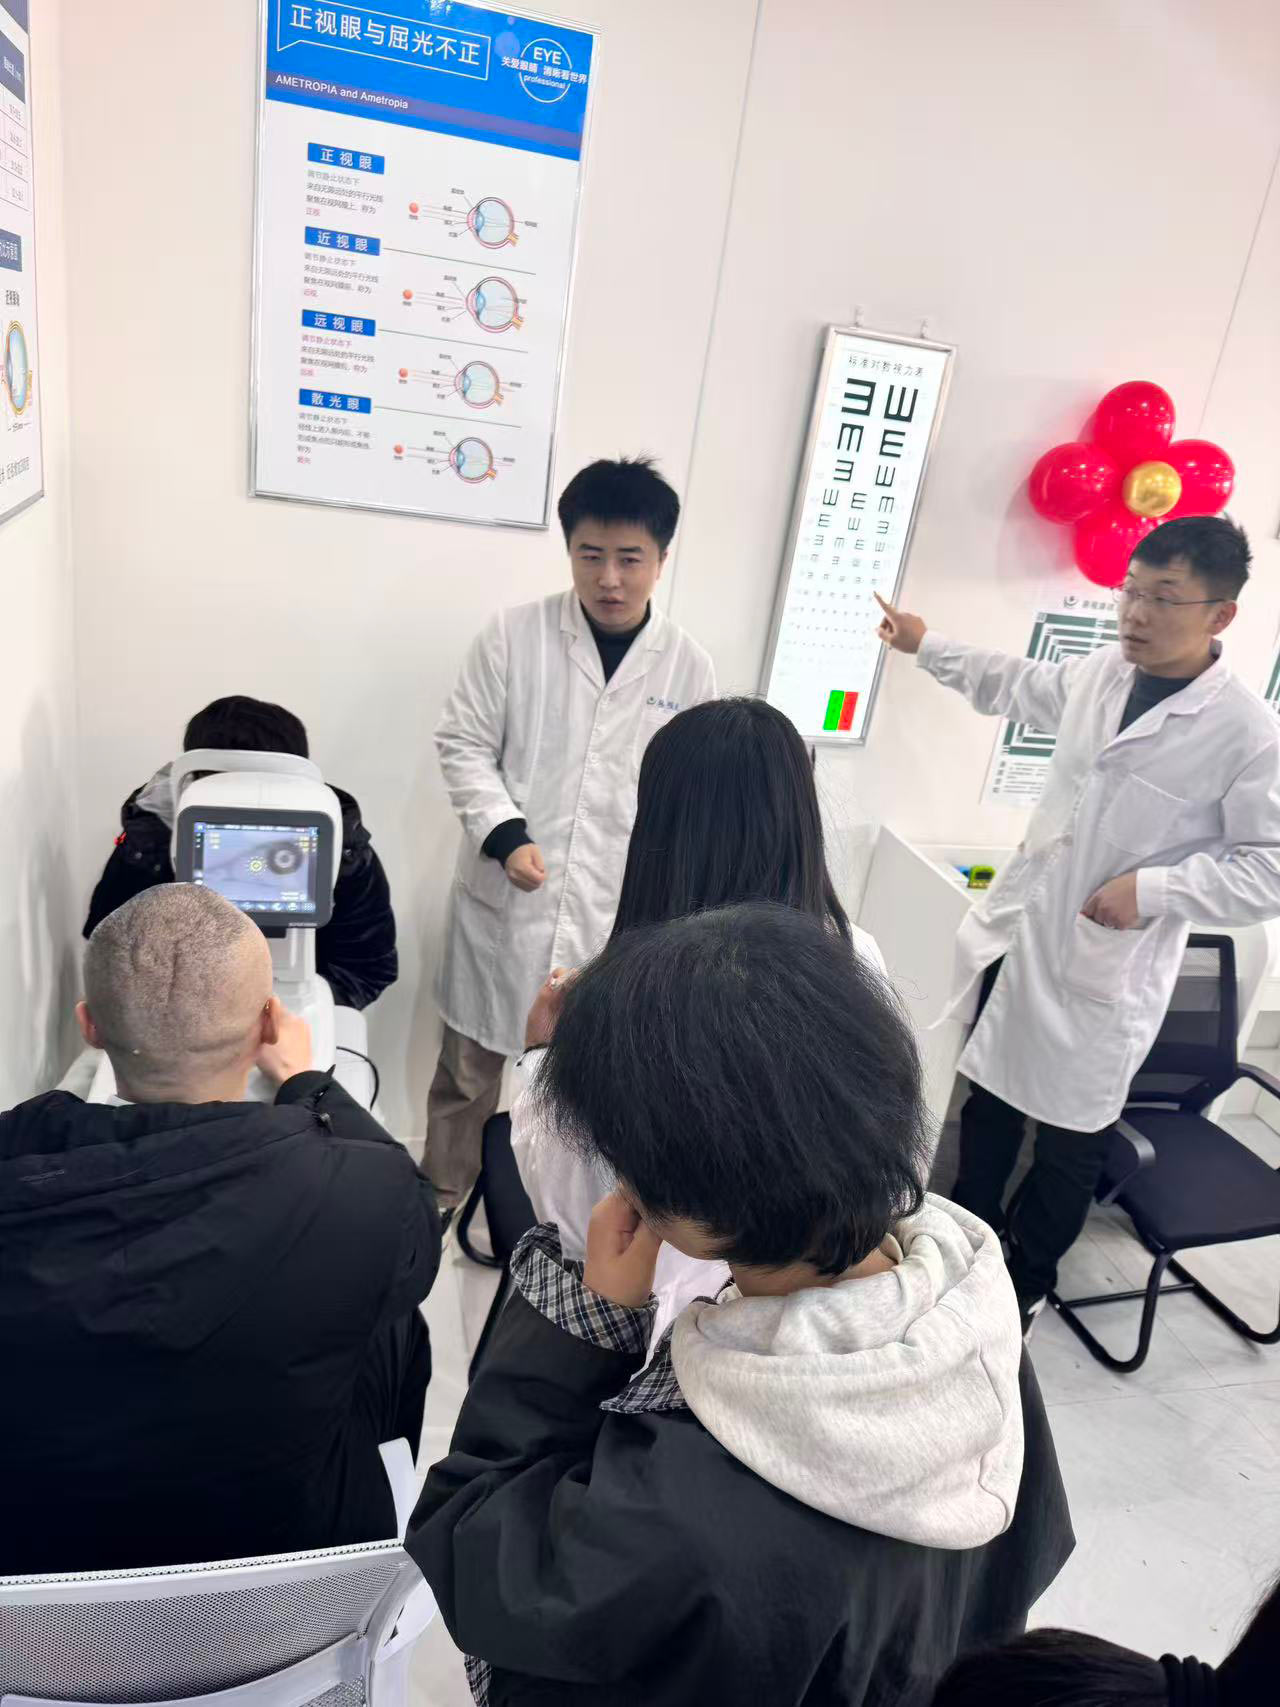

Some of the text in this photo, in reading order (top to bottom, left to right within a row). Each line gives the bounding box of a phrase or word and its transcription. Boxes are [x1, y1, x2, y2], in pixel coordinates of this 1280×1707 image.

[288, 4, 482, 67] 正视眼与屈光不正
[533, 46, 562, 66] EYE
[275, 73, 409, 110] AMETROPIA and Ametropia
[320, 147, 373, 170] 正视眼
[317, 230, 369, 252] 近视眼
[314, 312, 364, 333] 远视眼
[311, 392, 360, 411] 散光眼
